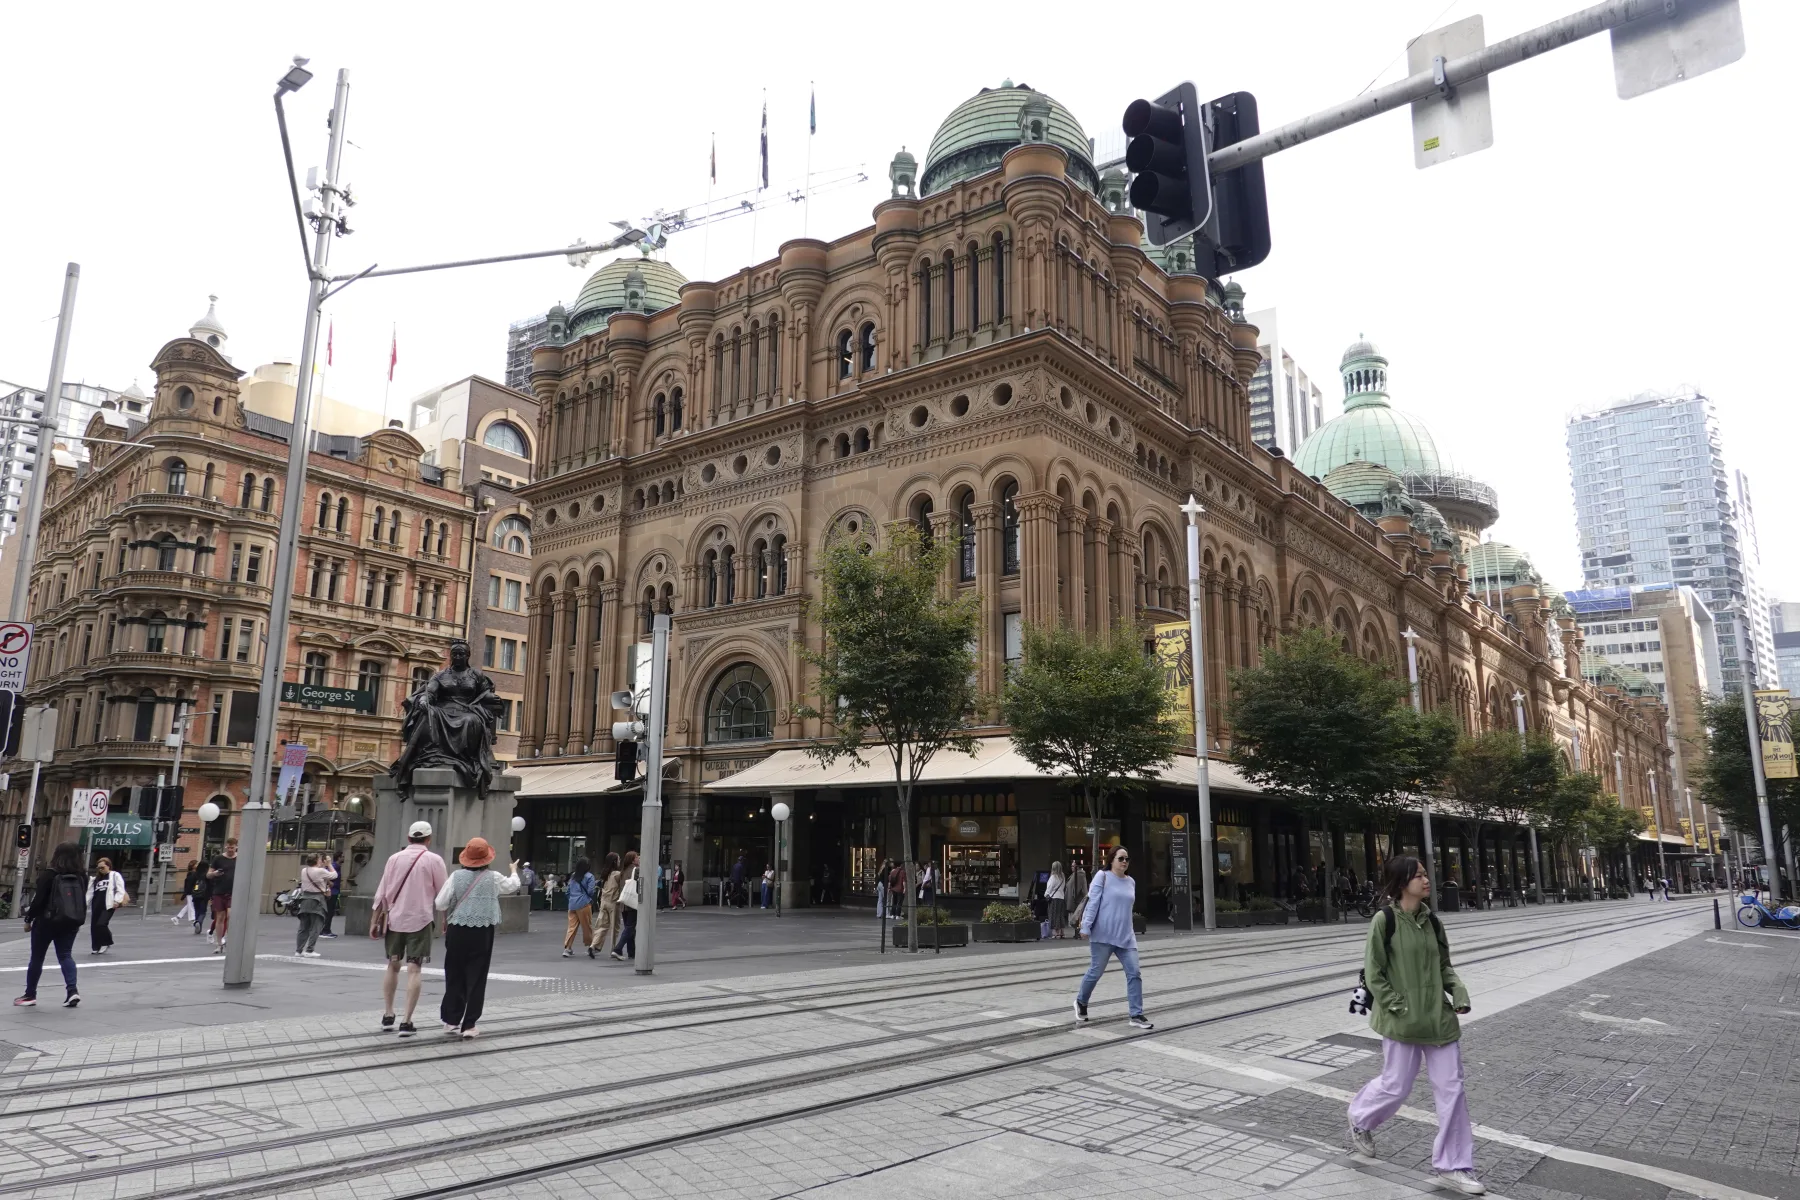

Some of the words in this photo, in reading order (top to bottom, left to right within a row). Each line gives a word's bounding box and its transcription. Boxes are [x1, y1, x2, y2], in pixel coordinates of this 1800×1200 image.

[0, 657, 18, 667] NO
[0, 670, 22, 678] GHT
[302, 687, 341, 702] George
[344, 691, 355, 701] St
[705, 761, 731, 771] QUEEN
[93, 798, 106, 809] 40
[88, 817, 105, 825] AREA
[94, 837, 131, 845] PEARLS
